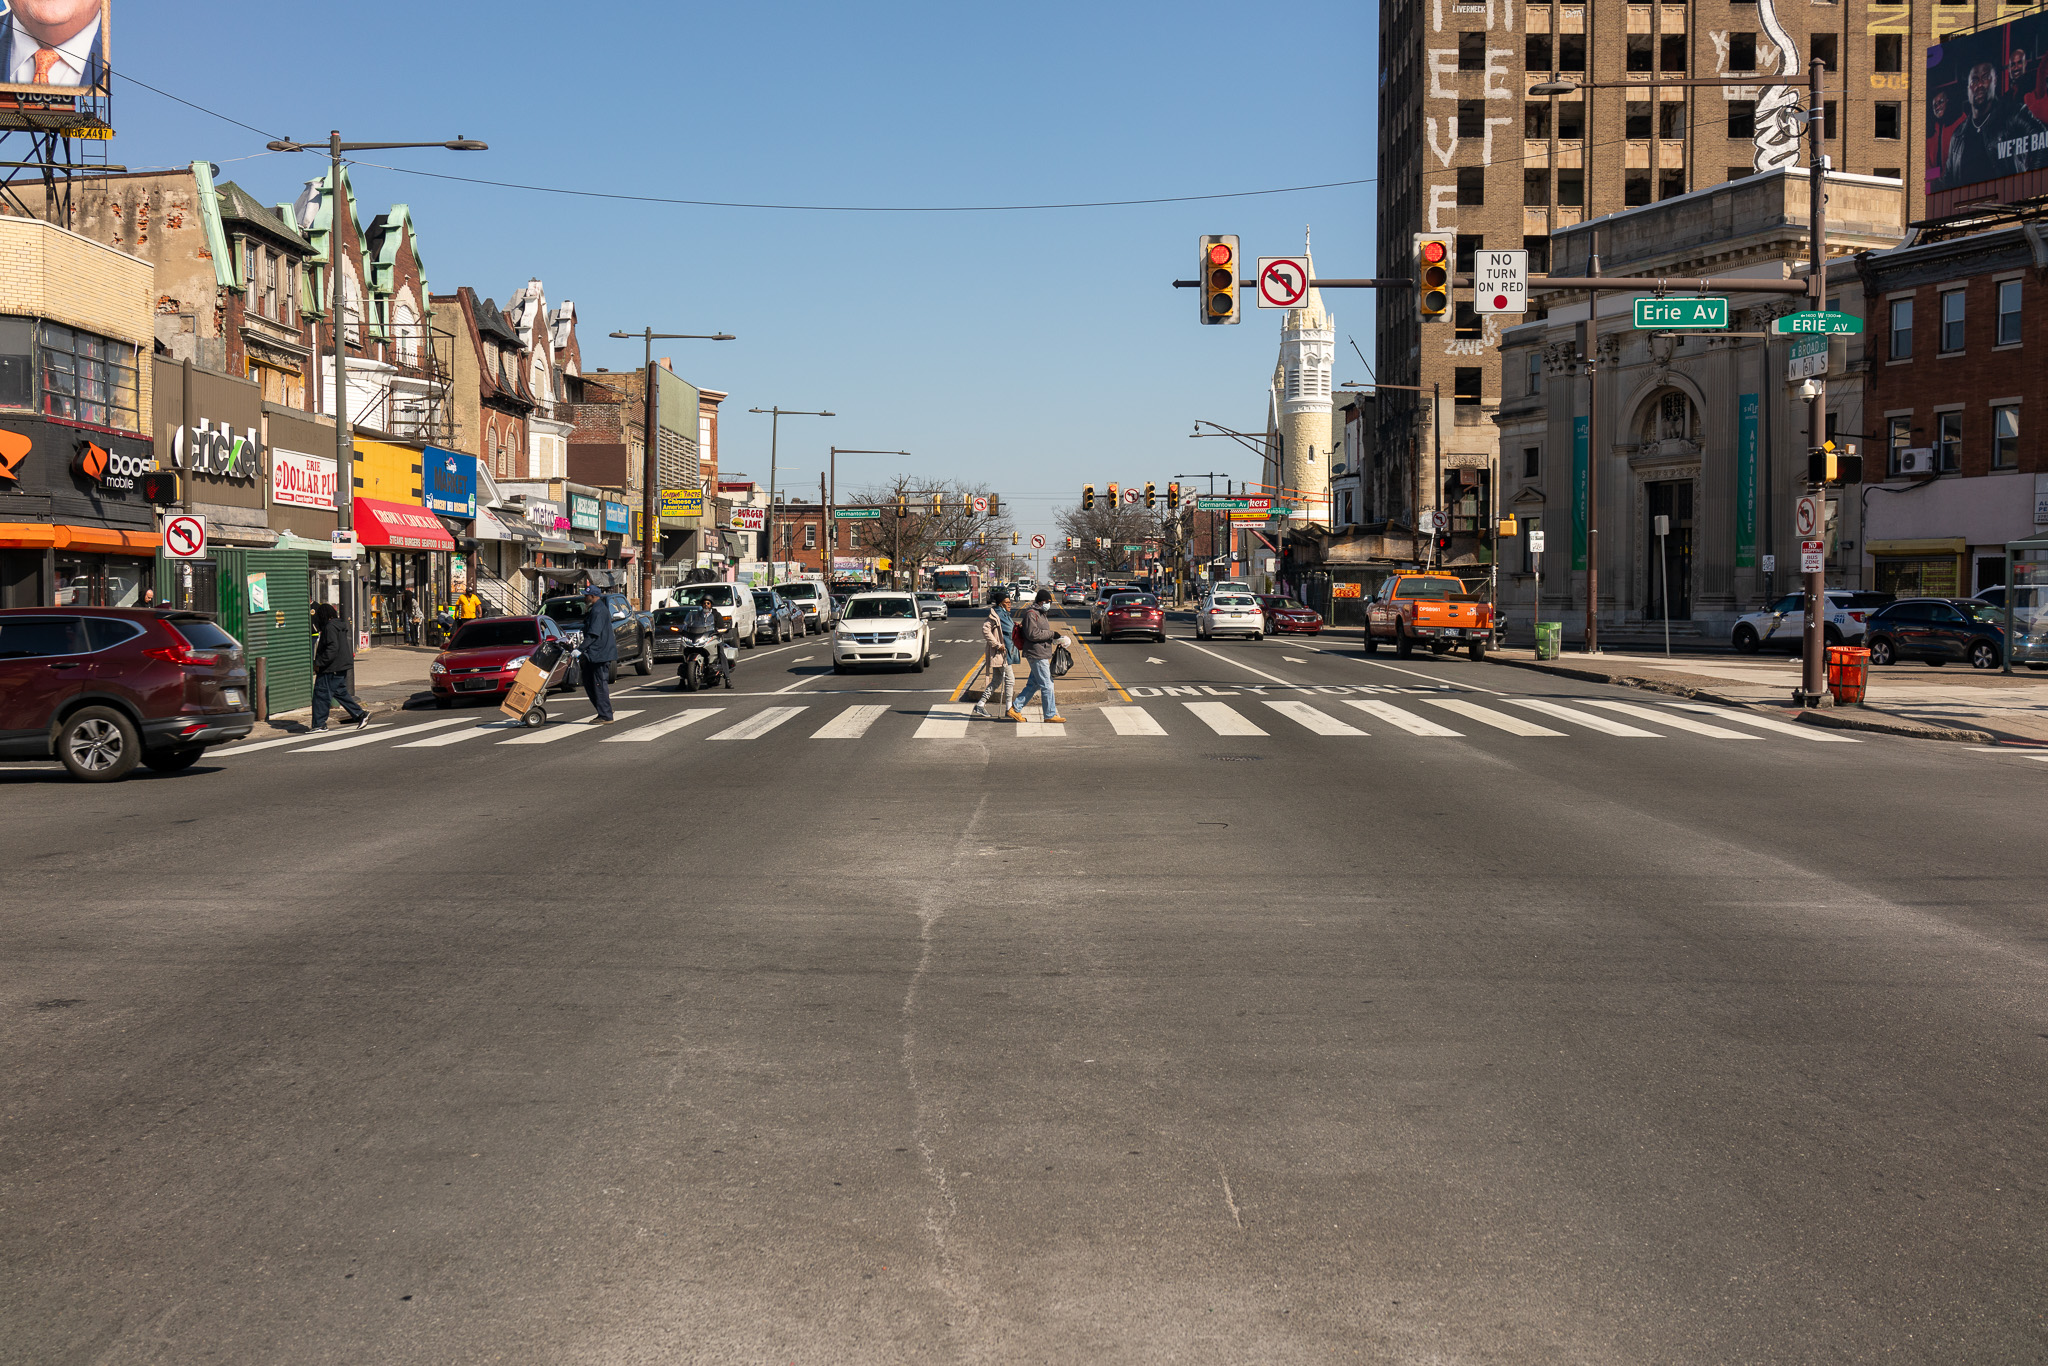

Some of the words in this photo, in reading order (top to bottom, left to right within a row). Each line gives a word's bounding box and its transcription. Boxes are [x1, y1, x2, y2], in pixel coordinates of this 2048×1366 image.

[1997, 135, 2029, 160] WE'RE
[1490, 254, 1512, 266] NO
[1486, 269, 1517, 279] TURN
[1478, 281, 1495, 292] ON
[1501, 281, 1524, 292] RED
[1643, 305, 1681, 320] Erie
[1693, 305, 1718, 320] Av
[1793, 319, 1826, 331] ERIE
[1833, 323, 1848, 331] AV
[1443, 338, 1484, 356] ZANE
[1797, 341, 1819, 357] BROAD
[1820, 342, 1826, 351] ST
[1790, 362, 1796, 378] N
[1804, 362, 1813, 372] 611
[1820, 355, 1826, 370] S
[109, 448, 151, 477] boos
[306, 459, 321, 472] ERIE
[106, 476, 134, 489] mobile
[282, 460, 319, 494] DOLLAR
[321, 472, 338, 496] PLU
[434, 466, 468, 495] MARKET
[1747, 430, 1755, 533] AVAILABLE
[372, 509, 405, 526] CROWN
[533, 504, 554, 526] metro
[737, 508, 764, 518] BURGER
[745, 519, 761, 529] LANE
[389, 535, 404, 546] STEAKS
[404, 536, 421, 547] BURGERS
[421, 538, 437, 548] SEAFOOD
[441, 540, 454, 550] SALADS
[1126, 685, 1270, 698] ONLY
